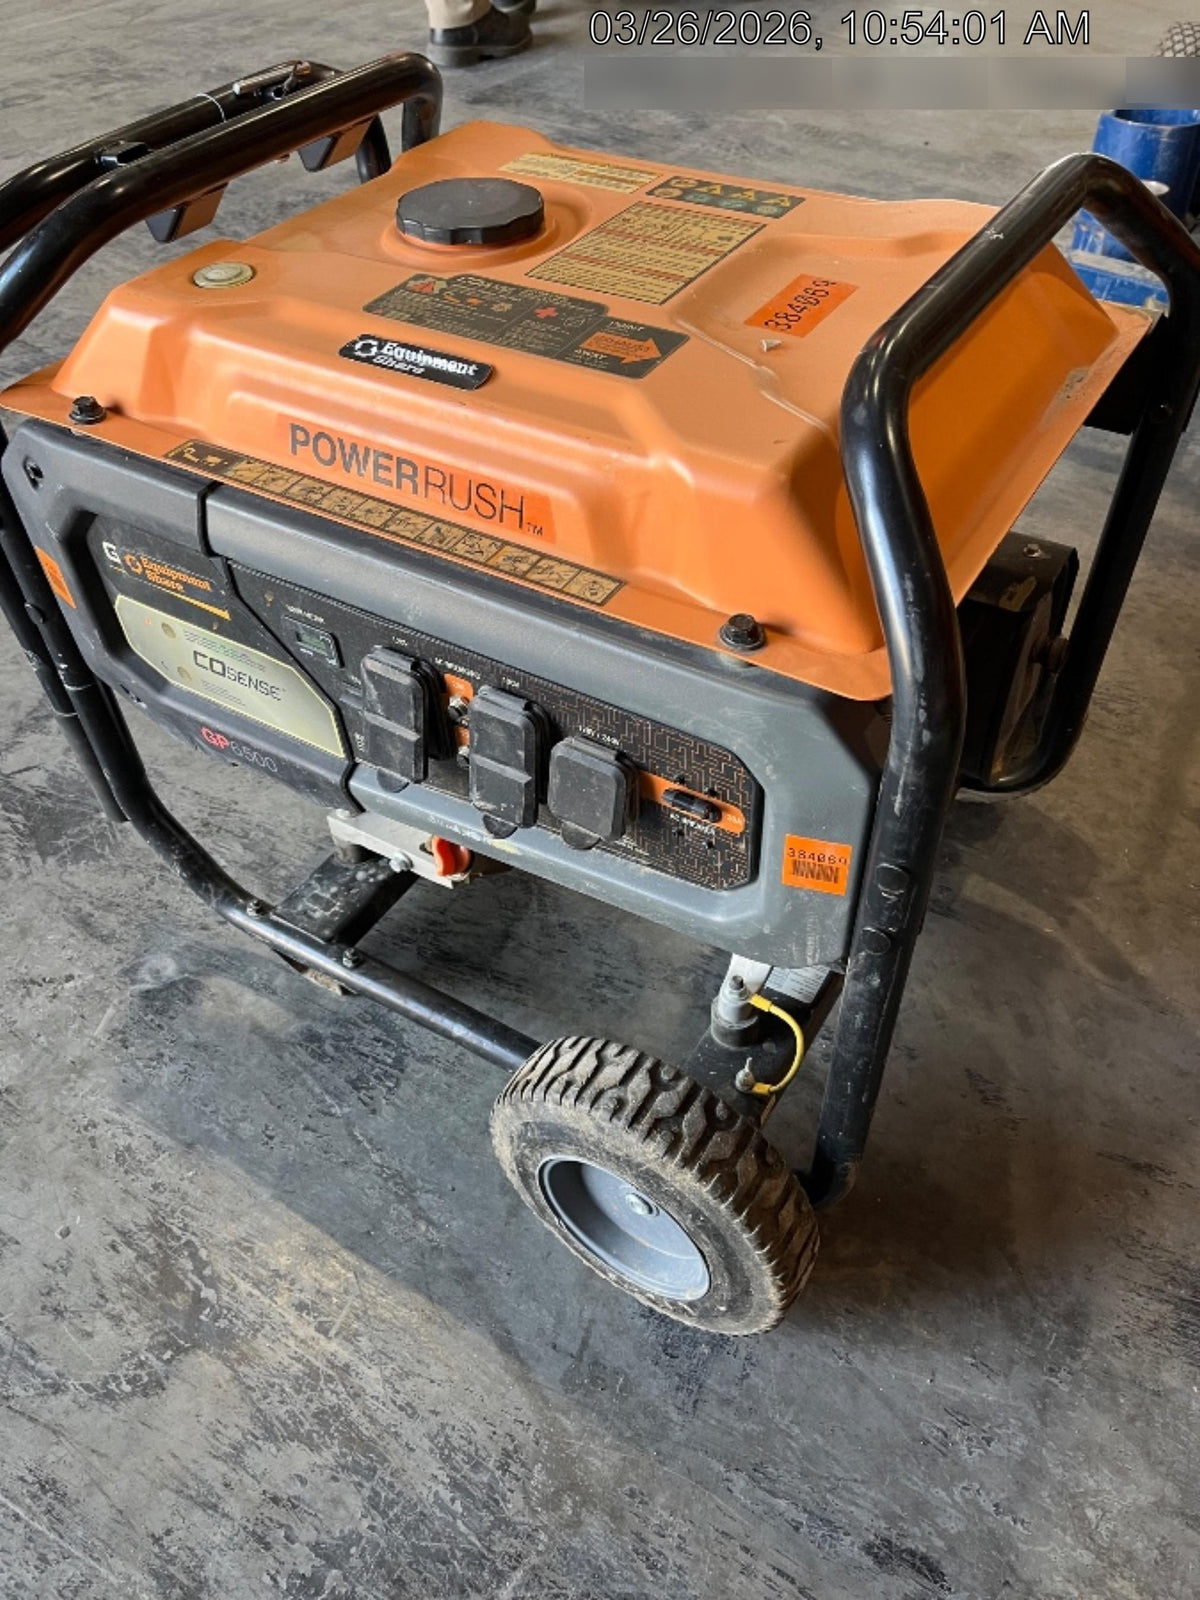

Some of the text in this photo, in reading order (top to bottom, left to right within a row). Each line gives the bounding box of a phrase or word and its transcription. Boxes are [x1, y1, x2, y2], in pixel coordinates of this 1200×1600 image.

[382, 342, 478, 376] Equipment
[140, 554, 213, 593] Equipment
[144, 569, 184, 593] Share
[200, 726, 278, 773] GP6500
